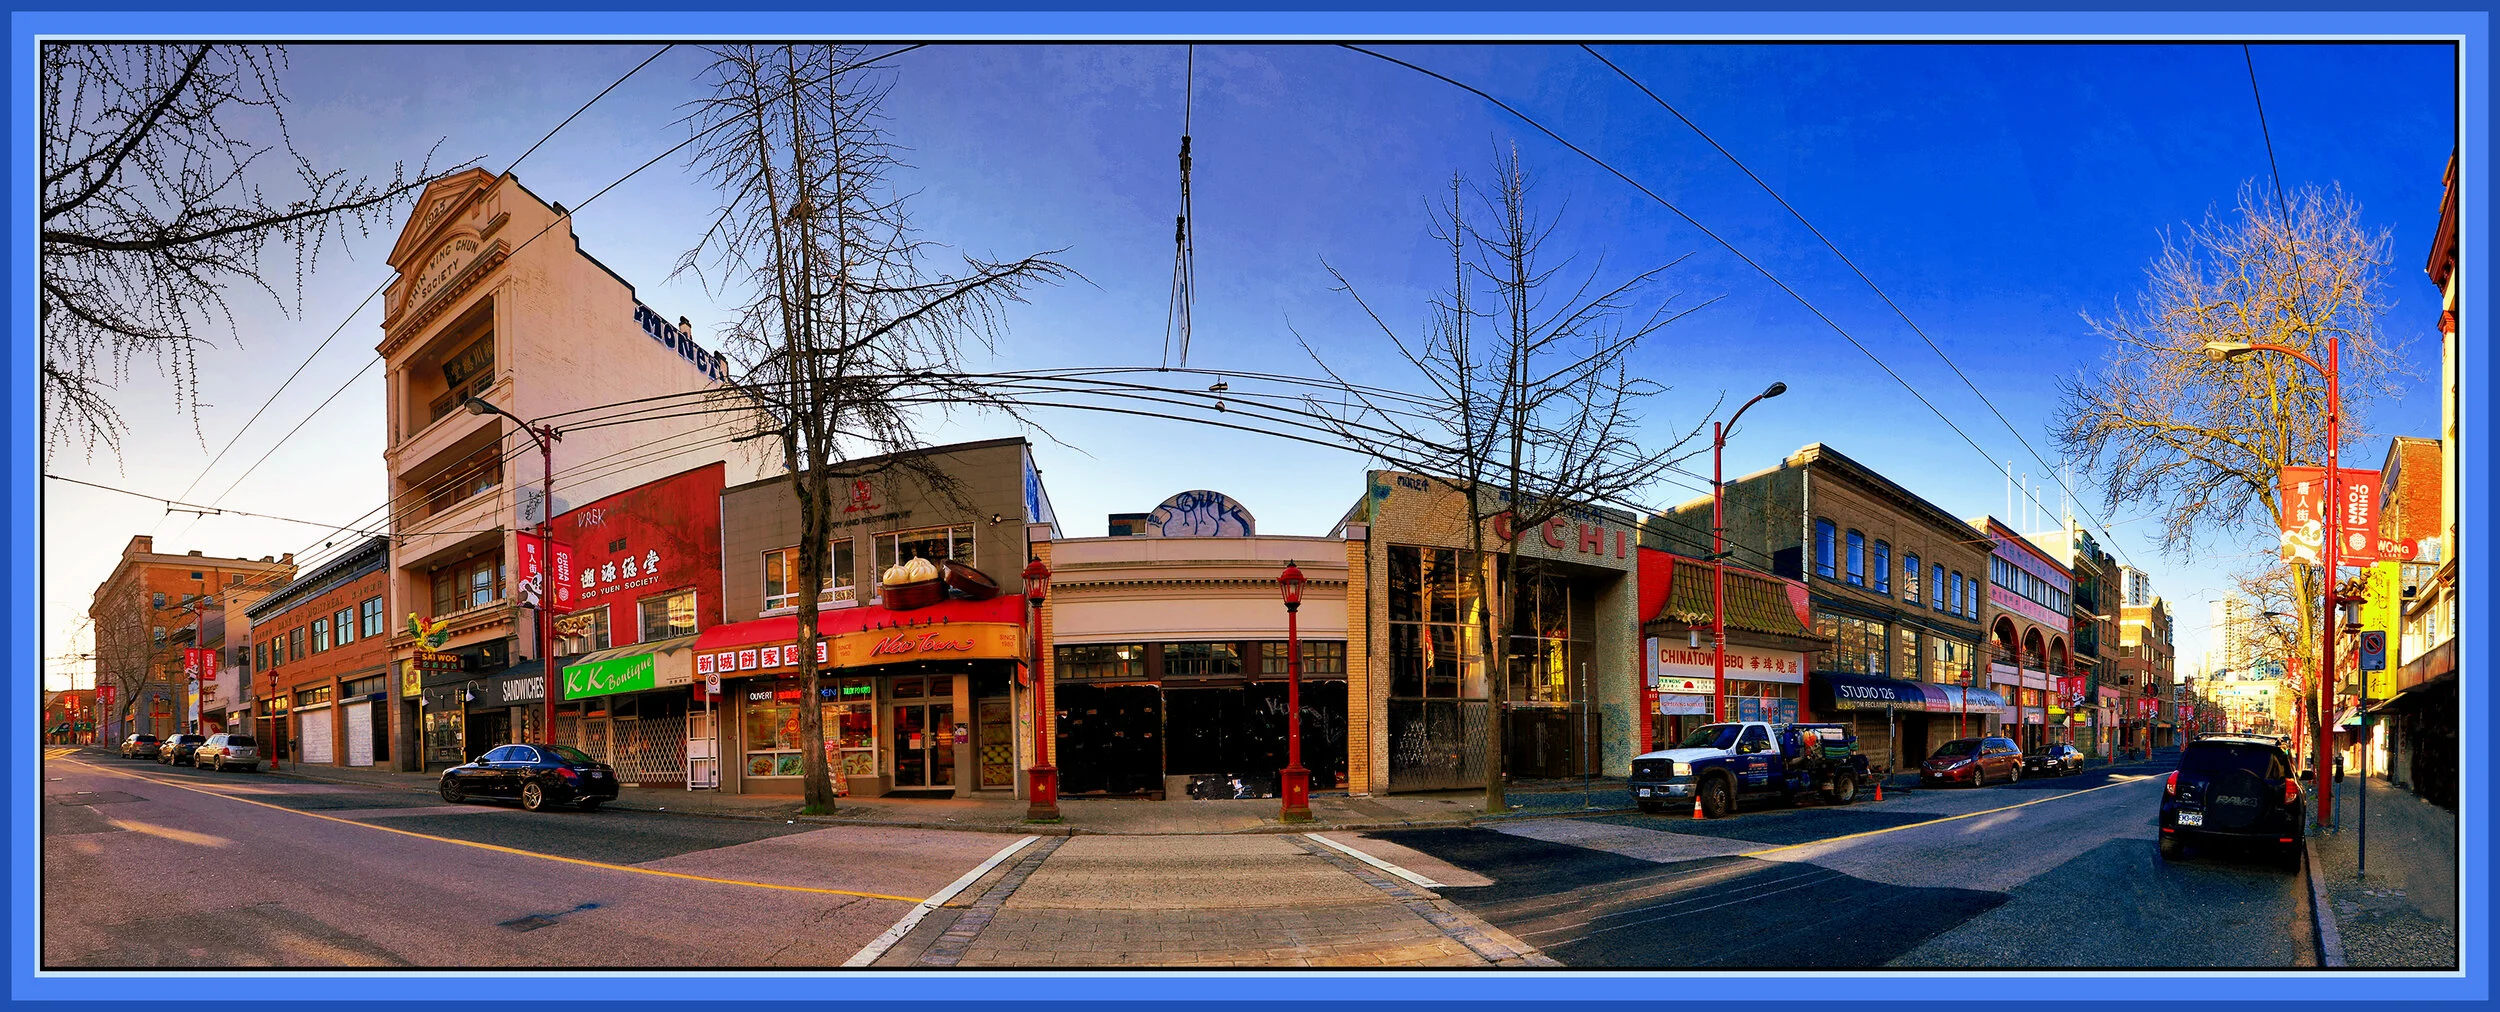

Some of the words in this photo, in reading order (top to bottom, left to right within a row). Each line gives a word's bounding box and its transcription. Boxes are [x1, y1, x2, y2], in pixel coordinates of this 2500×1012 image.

[425, 200, 446, 228] 1925
[429, 245, 451, 270] WING
[455, 239, 479, 254] CHUN
[421, 258, 459, 298] SOCIETY
[2297, 481, 2309, 521] 唐人街
[2348, 484, 2359, 525] TOWN
[2358, 484, 2369, 525] CHINA
[2377, 539, 2410, 554] WONG
[556, 551, 564, 580] TOWN
[561, 553, 570, 582] CHINA
[581, 590, 597, 599] SOO
[600, 584, 621, 594] YUEN
[624, 576, 660, 589] SOCIETY
[437, 654, 458, 662] WOO
[869, 633, 916, 657] New
[917, 632, 976, 653] Town
[1661, 648, 1714, 667] CHINATOW
[1724, 654, 1744, 670] BBQ
[502, 676, 544, 702] SANDWICHES
[566, 670, 583, 695] K
[605, 656, 652, 691] Boutique
[749, 691, 773, 701] OUVERT
[1840, 684, 1879, 699] STUDIO
[1879, 687, 1895, 700] 126
